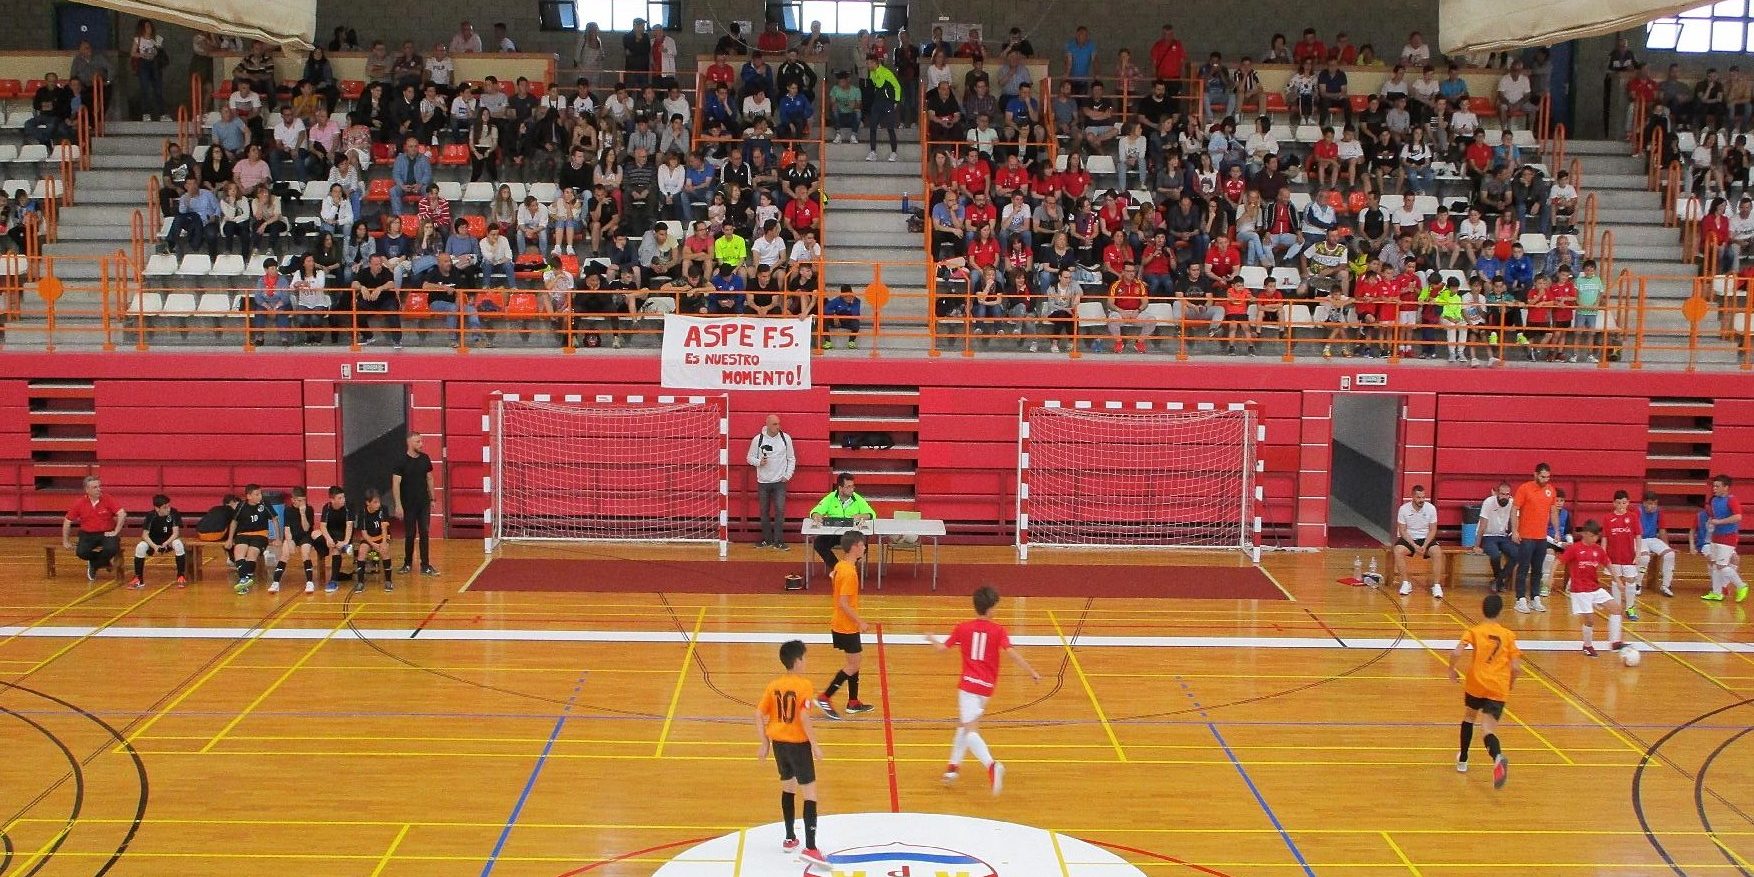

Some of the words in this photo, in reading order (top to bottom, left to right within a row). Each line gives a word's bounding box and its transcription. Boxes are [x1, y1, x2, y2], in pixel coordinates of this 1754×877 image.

[684, 324, 756, 348] ASPE
[763, 326, 799, 348] F.S.
[705, 353, 760, 366] NUESTRO
[722, 365, 802, 386] MOMENTO!
[250, 514, 259, 523] 10
[971, 631, 987, 661] 11
[1487, 635, 1502, 664] 7
[774, 689, 797, 724] 10
